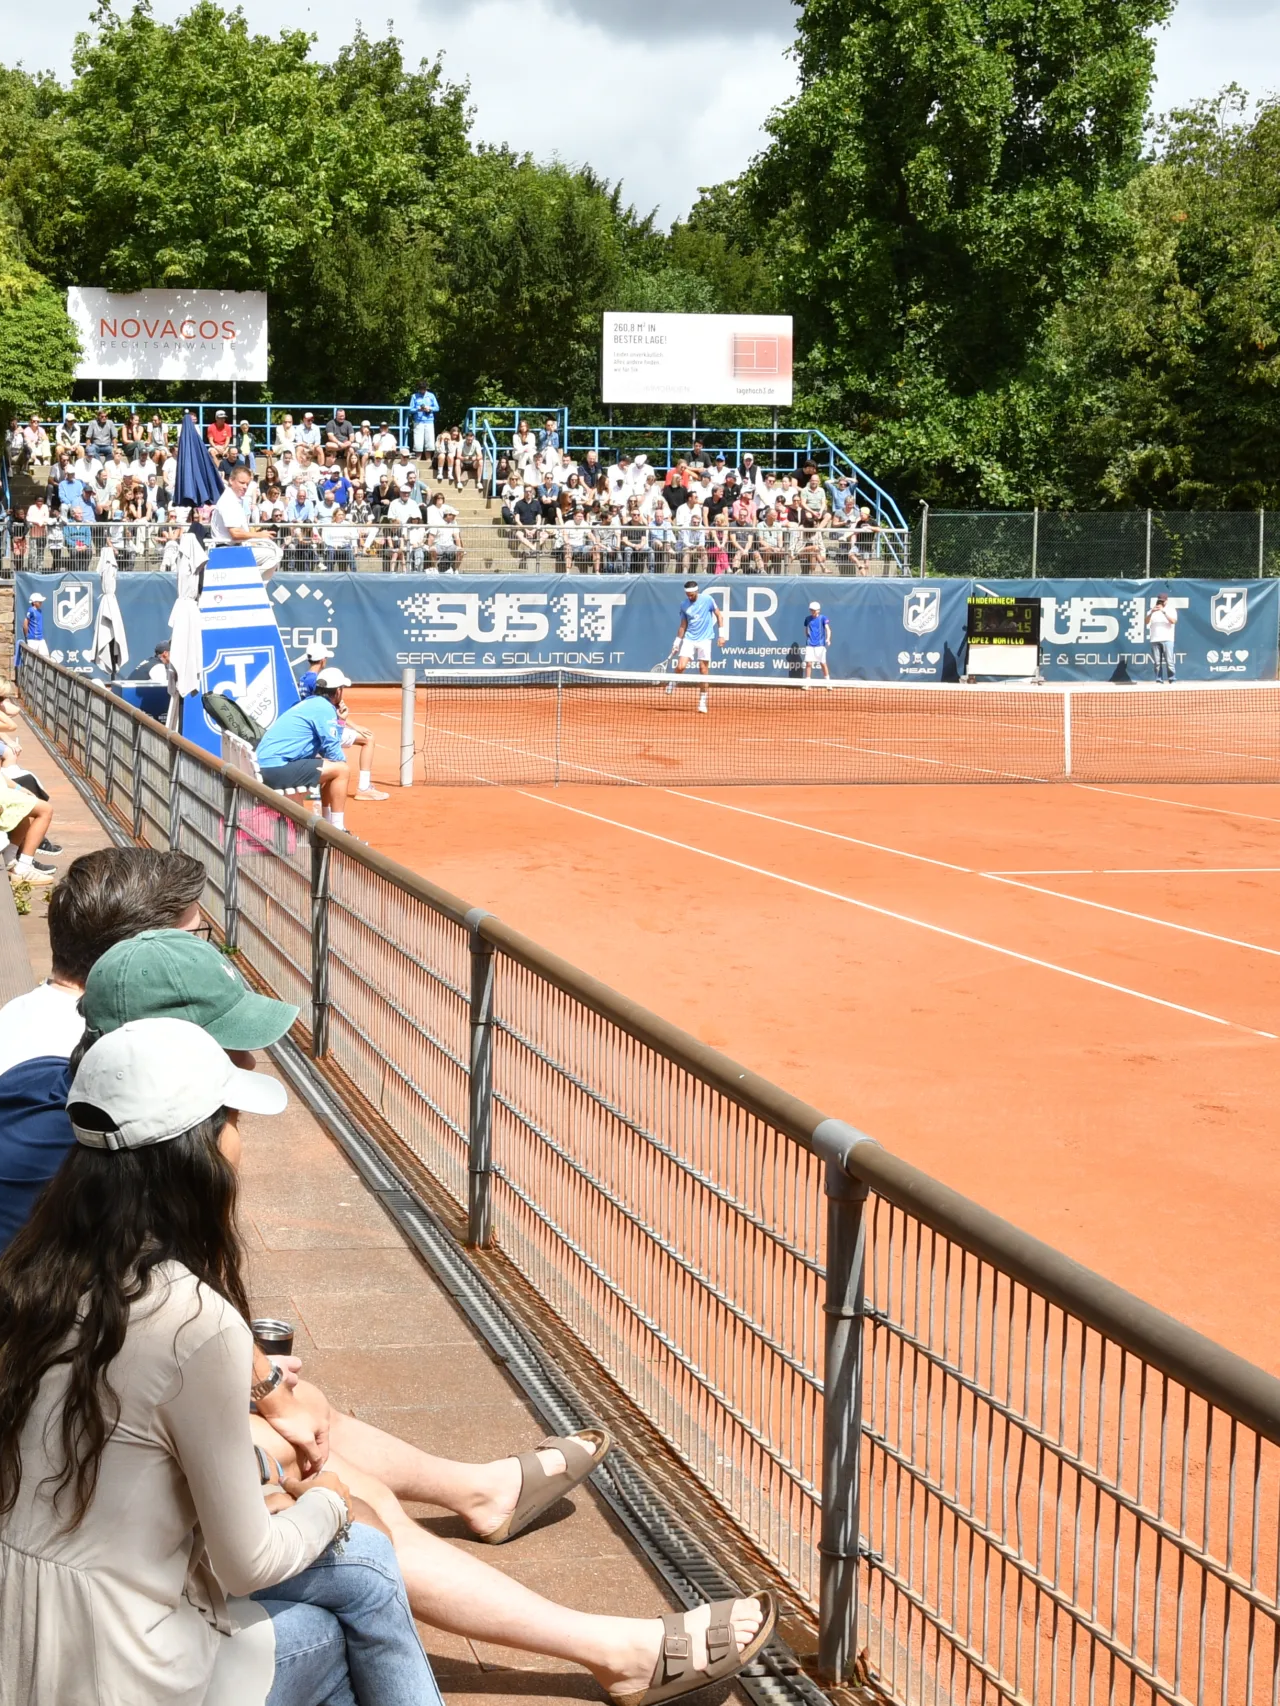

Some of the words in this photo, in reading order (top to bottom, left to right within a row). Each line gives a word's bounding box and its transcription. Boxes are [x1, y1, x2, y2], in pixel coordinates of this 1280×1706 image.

[100, 318, 236, 340] NOVACOS
[613, 323, 635, 332] 260,8
[648, 324, 656, 332] IN
[613, 334, 643, 344] BESTER
[645, 336, 667, 345] LAGE!
[967, 597, 1016, 605] RINDERKNECH
[1040, 597, 1119, 645] US
[967, 636, 989, 644] LOPEZ
[396, 652, 475, 665] SERVICE
[482, 652, 496, 665] &
[502, 652, 604, 665] SOLUTIONS
[609, 652, 624, 664] IT
[733, 659, 765, 669] Neuss
[1056, 653, 1069, 665] &
[1075, 653, 1165, 665] SOLUTION
[251, 697, 272, 721] EUSS
